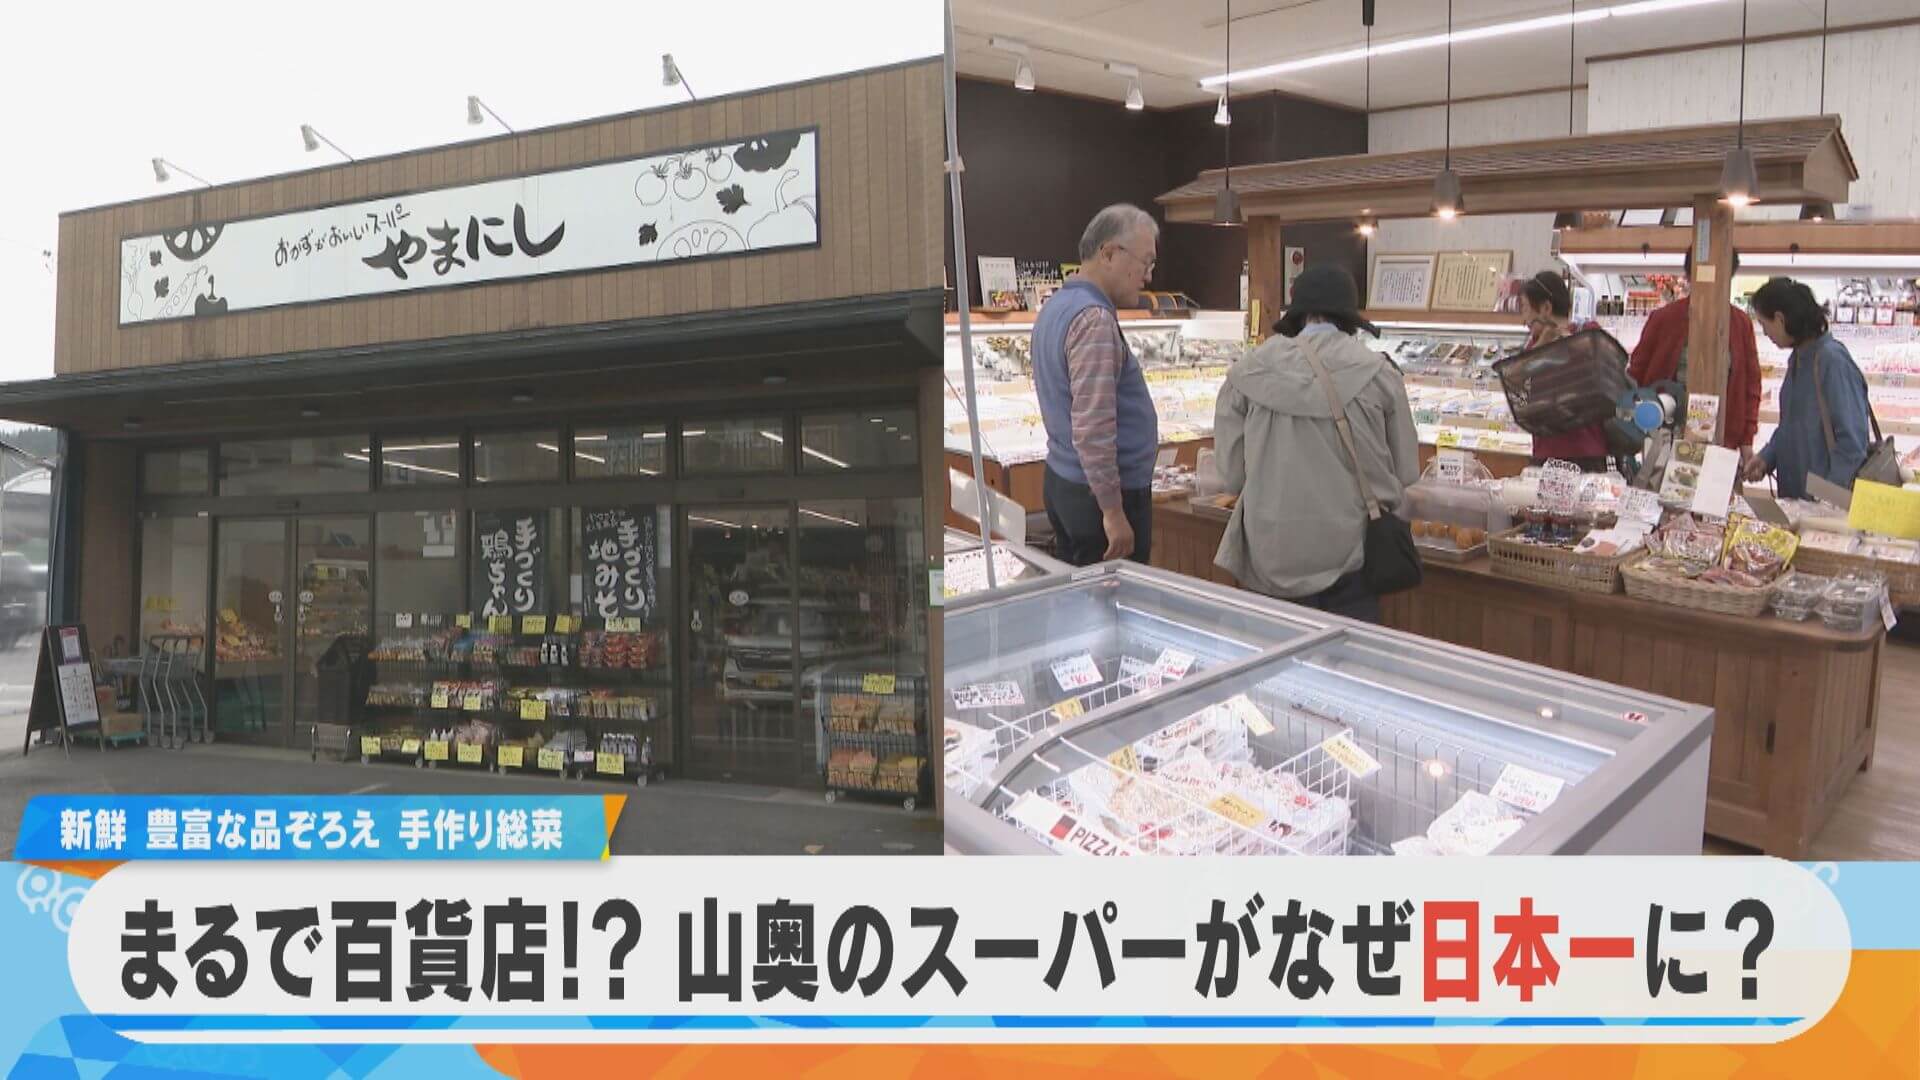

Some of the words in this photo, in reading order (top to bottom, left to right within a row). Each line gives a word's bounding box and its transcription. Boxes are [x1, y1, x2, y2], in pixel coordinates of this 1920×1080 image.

[274, 203, 411, 268] おかずがおいしいスーパー
[361, 202, 566, 280] やまにし
[480, 529, 514, 618] 鶏ちゃん
[514, 516, 542, 613] 手づくり
[588, 536, 621, 619] 地みそ
[616, 518, 646, 611] 手づくり
